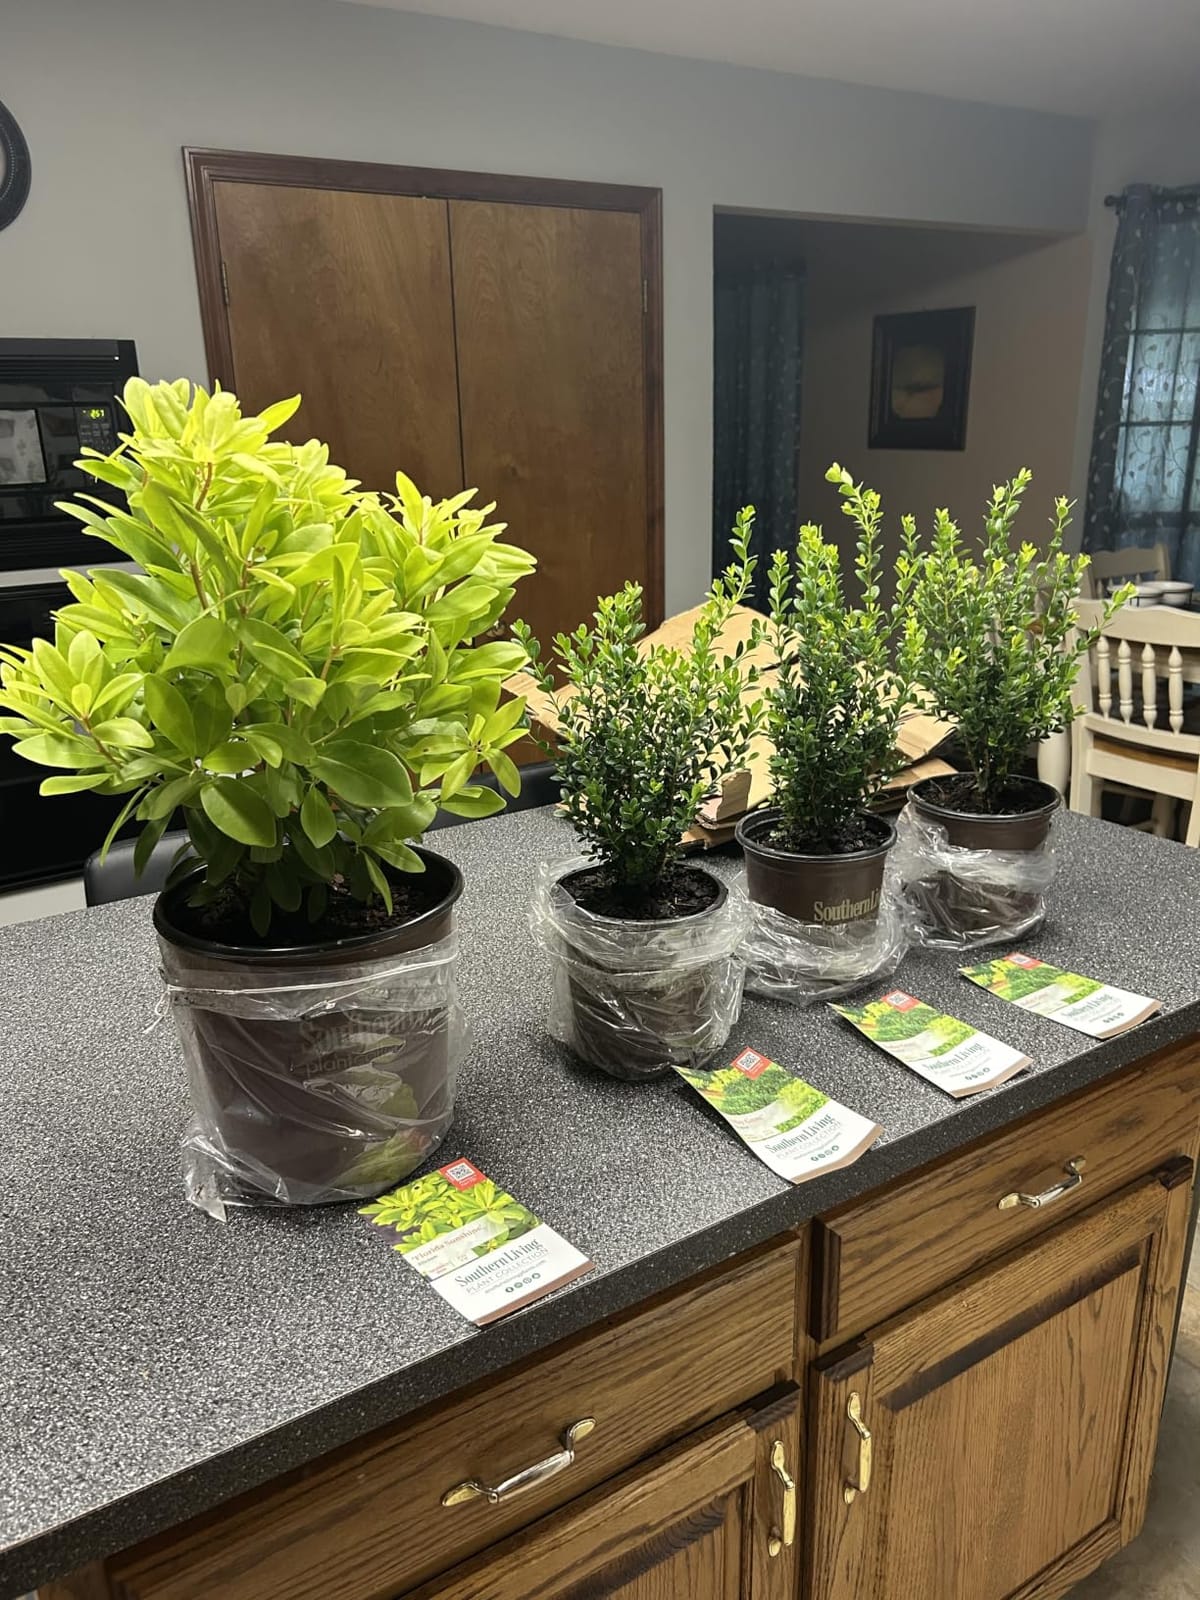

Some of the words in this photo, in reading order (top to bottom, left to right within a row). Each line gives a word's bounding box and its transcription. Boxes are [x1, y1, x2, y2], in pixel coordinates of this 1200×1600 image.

[814, 898, 870, 921] Southern
[765, 1134, 809, 1154] Southern
[802, 1114, 835, 1137] Living
[455, 1257, 509, 1287] Southern
[503, 1239, 543, 1261] Living
[466, 1276, 494, 1294] PLANT
[495, 1248, 549, 1279] COLLECTION
